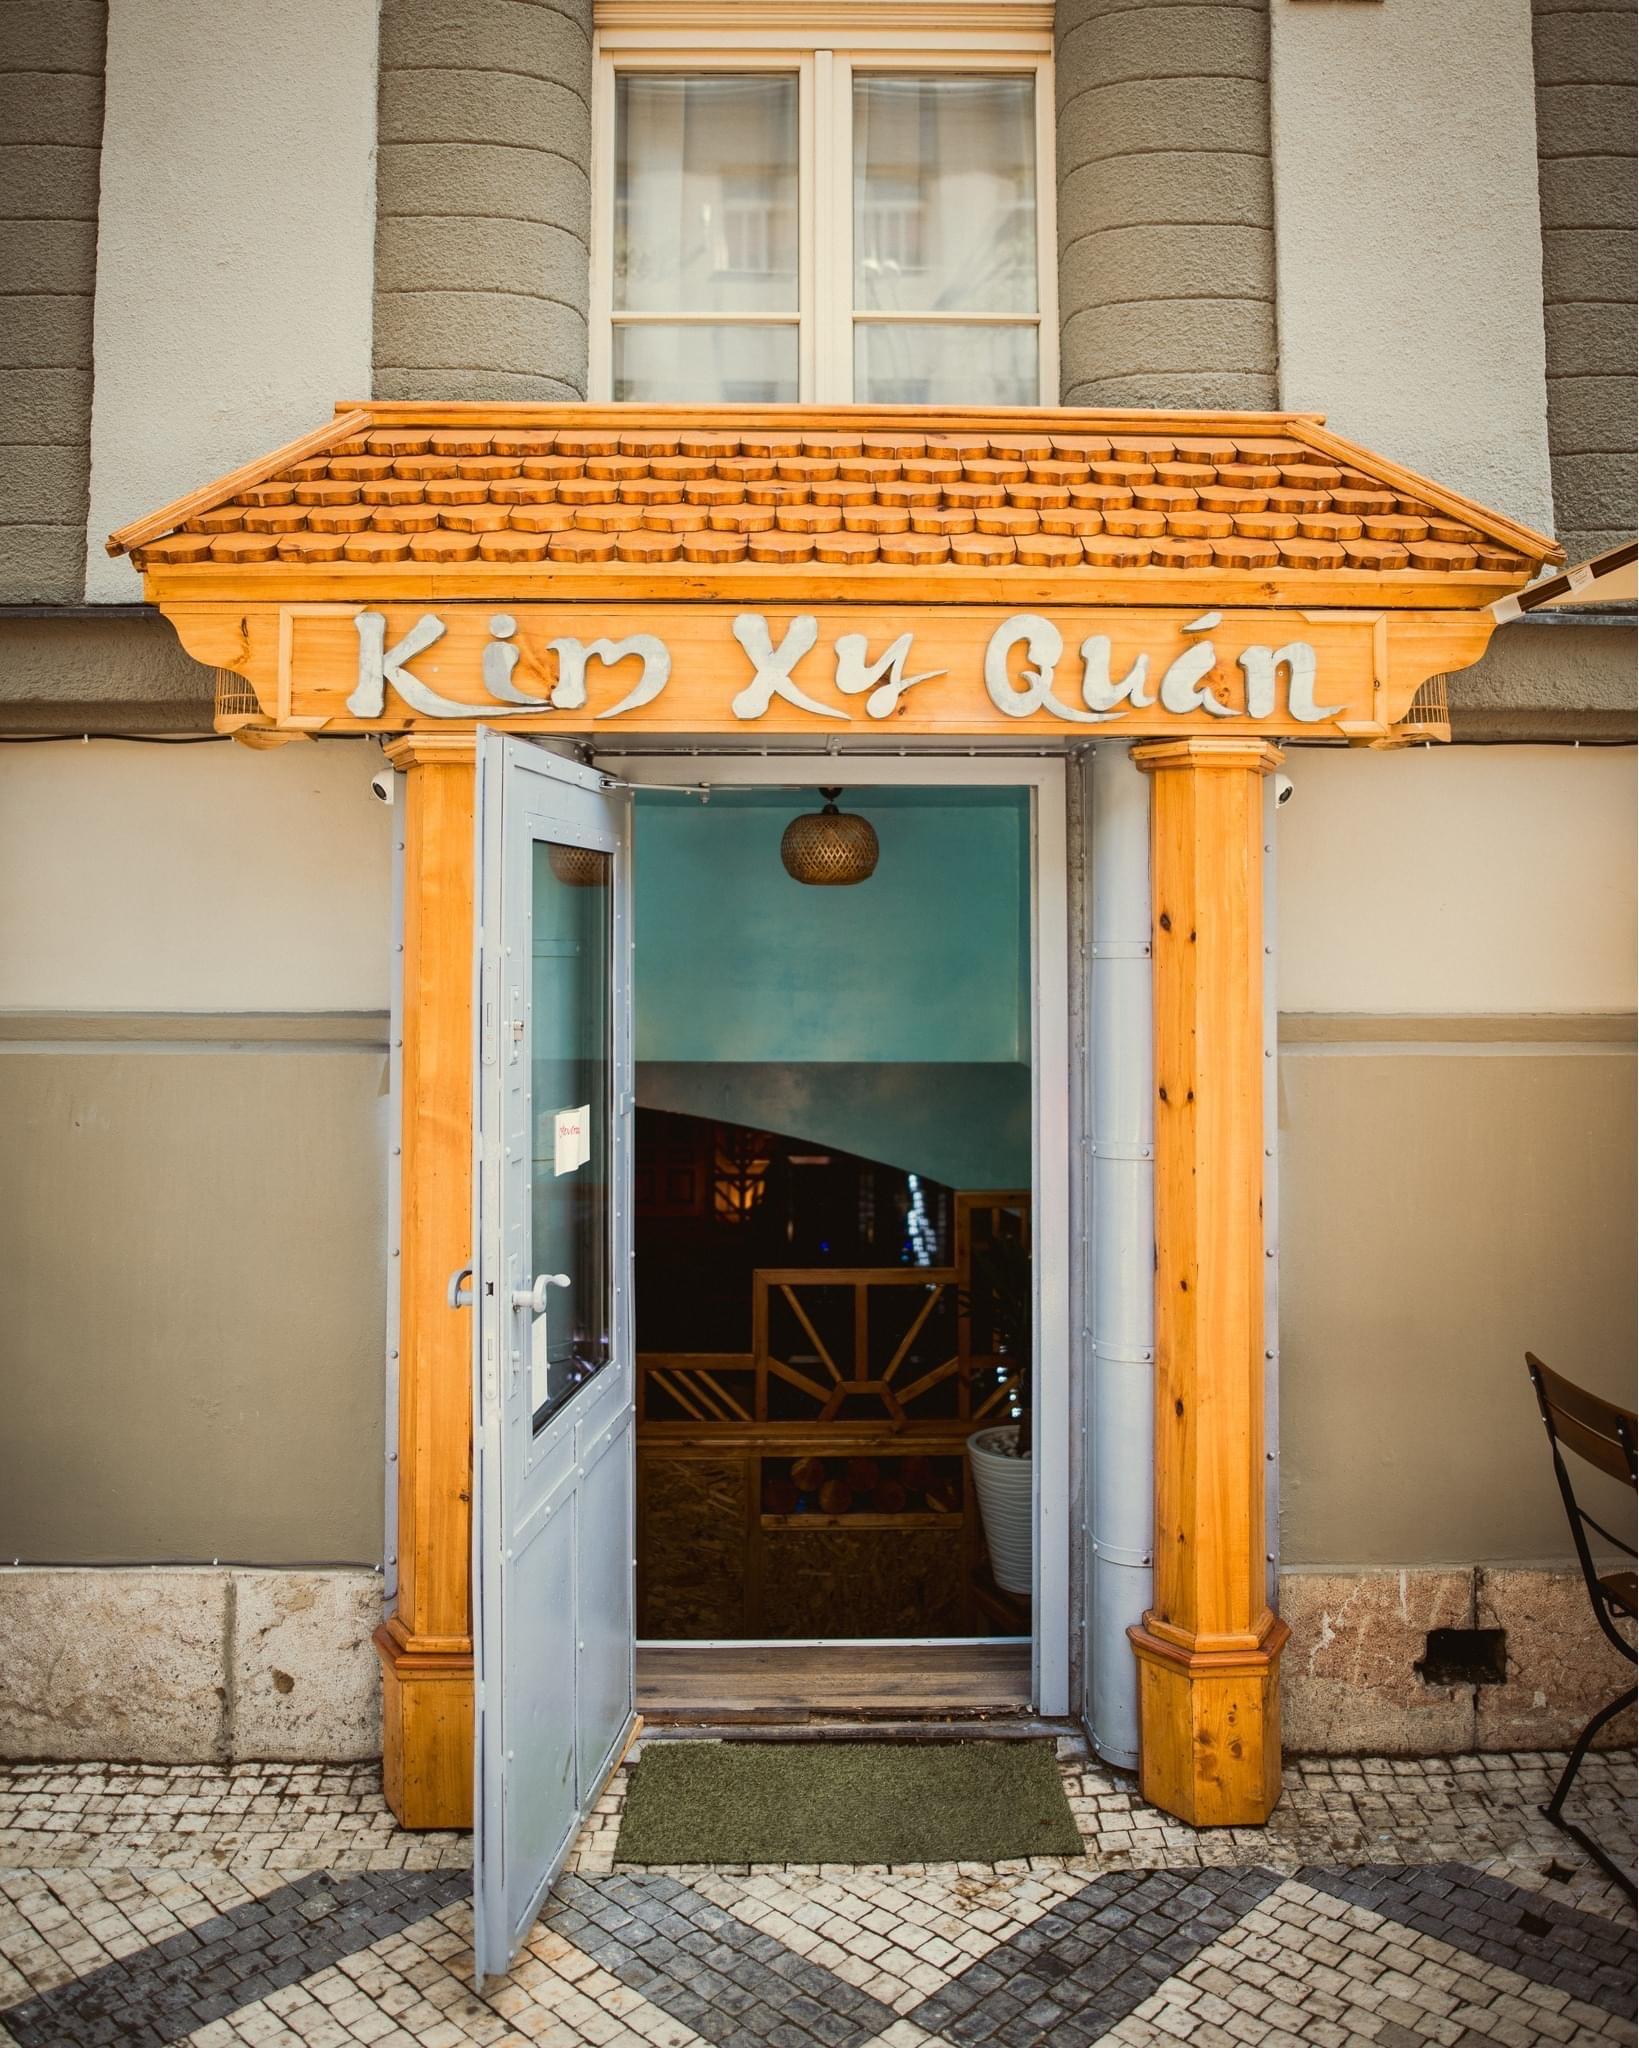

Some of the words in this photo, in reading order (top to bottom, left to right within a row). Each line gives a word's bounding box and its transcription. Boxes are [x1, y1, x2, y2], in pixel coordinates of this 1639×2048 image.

[346, 612, 671, 719] Kim
[731, 613, 949, 720] Xy
[975, 611, 1348, 722] Quán
